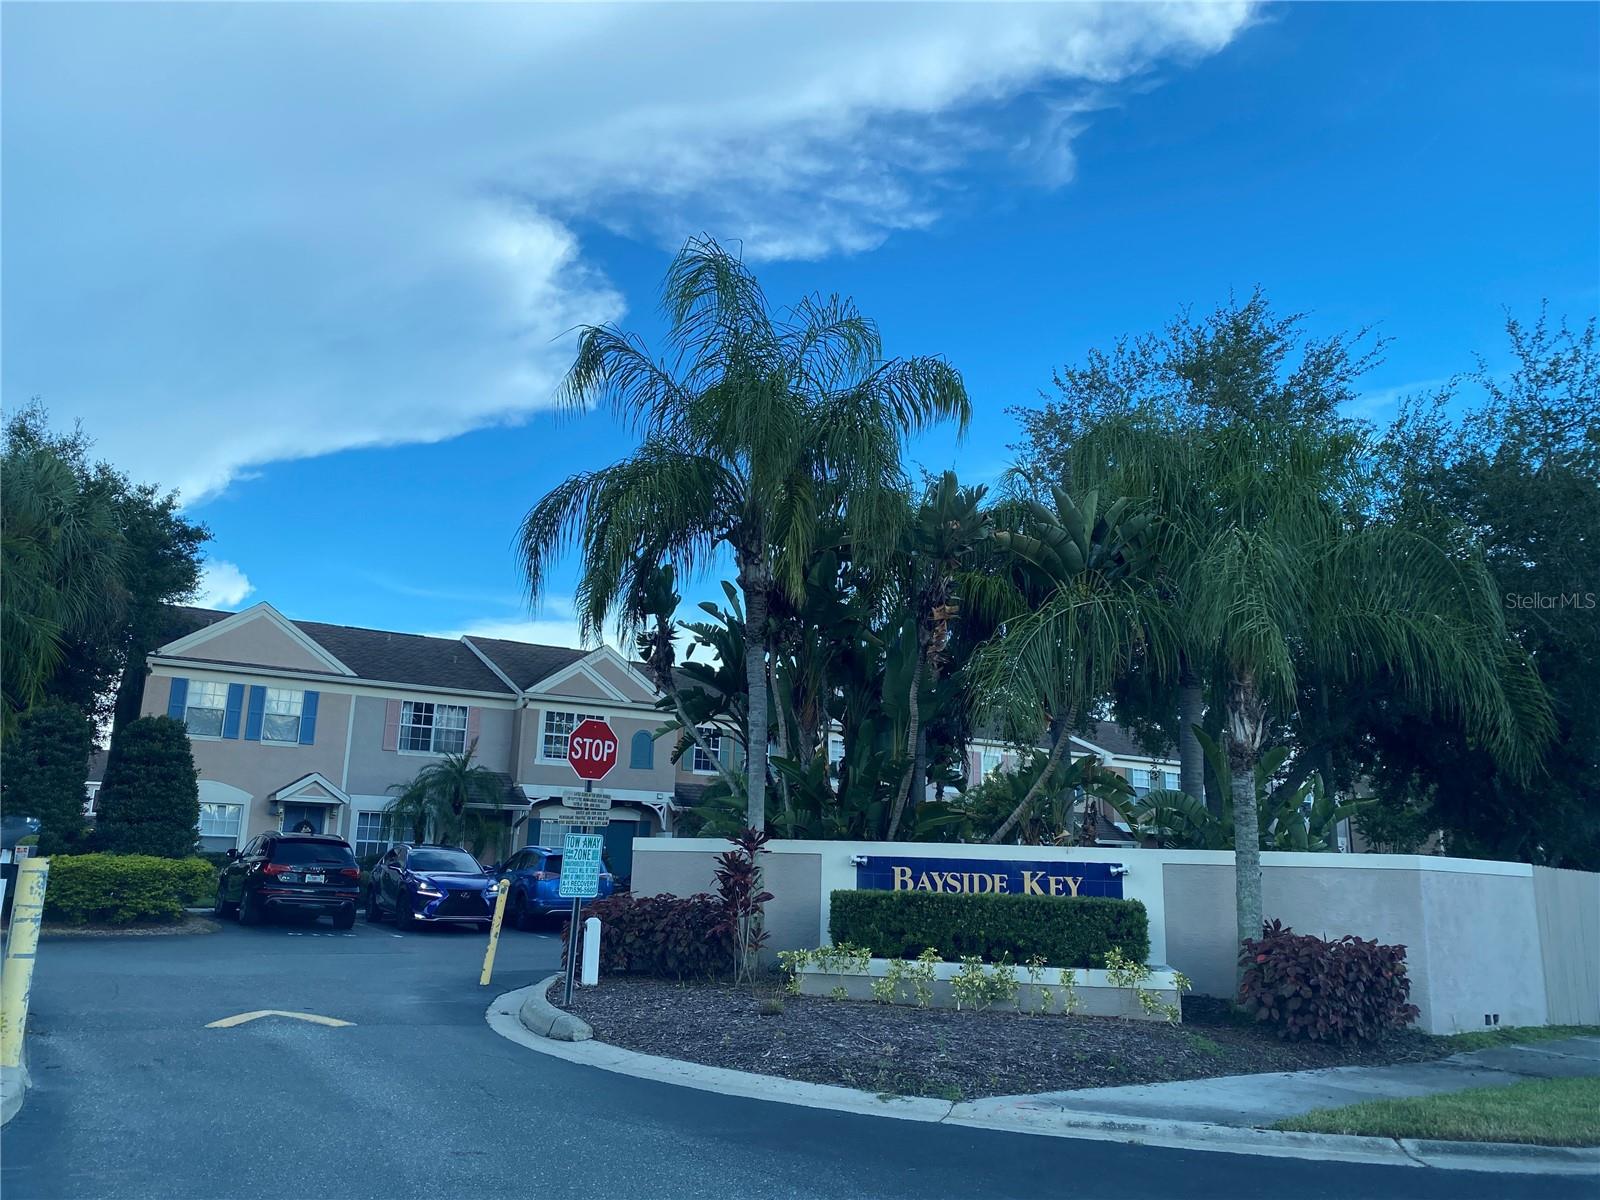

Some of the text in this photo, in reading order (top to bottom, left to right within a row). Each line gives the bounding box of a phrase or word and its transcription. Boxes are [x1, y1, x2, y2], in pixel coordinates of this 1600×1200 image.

[571, 737, 615, 762] STOP
[566, 836, 601, 849] TOW AWAY
[573, 848, 592, 861] ZONE
[892, 866, 1084, 897] BAYSIDE KEY
